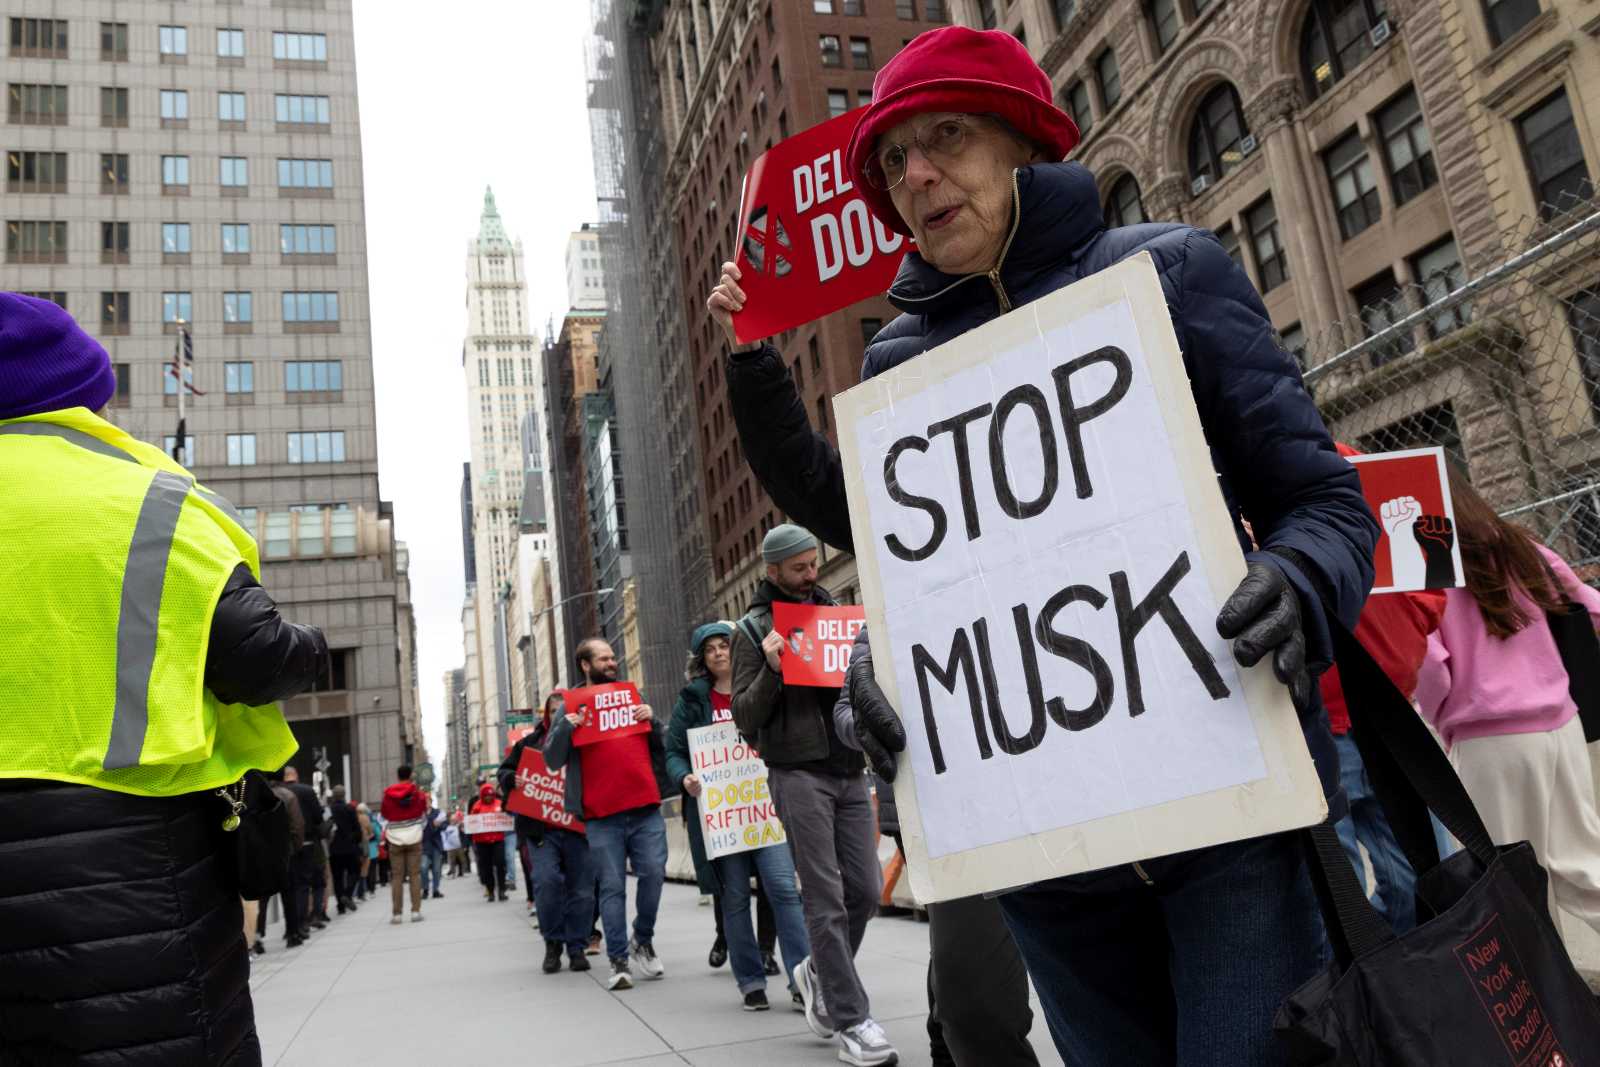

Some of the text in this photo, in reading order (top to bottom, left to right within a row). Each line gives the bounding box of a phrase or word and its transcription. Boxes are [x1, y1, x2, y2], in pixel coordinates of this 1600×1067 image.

[793, 148, 853, 214] DEL
[883, 345, 1133, 562] STOP
[823, 643, 853, 673] DO
[911, 550, 1232, 775] MUSK
[594, 689, 633, 710] DELETE
[599, 704, 638, 732] DOGE
[693, 744, 761, 769] ILLION
[702, 768, 732, 783] WHO
[523, 783, 565, 807] SUPP
[706, 776, 769, 810] DOGE
[541, 804, 573, 825] YOU
[711, 832, 737, 849] HIS
[1466, 937, 1500, 971] New
[1480, 961, 1513, 996] York
[1493, 979, 1531, 1026] Public
[1508, 1008, 1542, 1053] Radio
